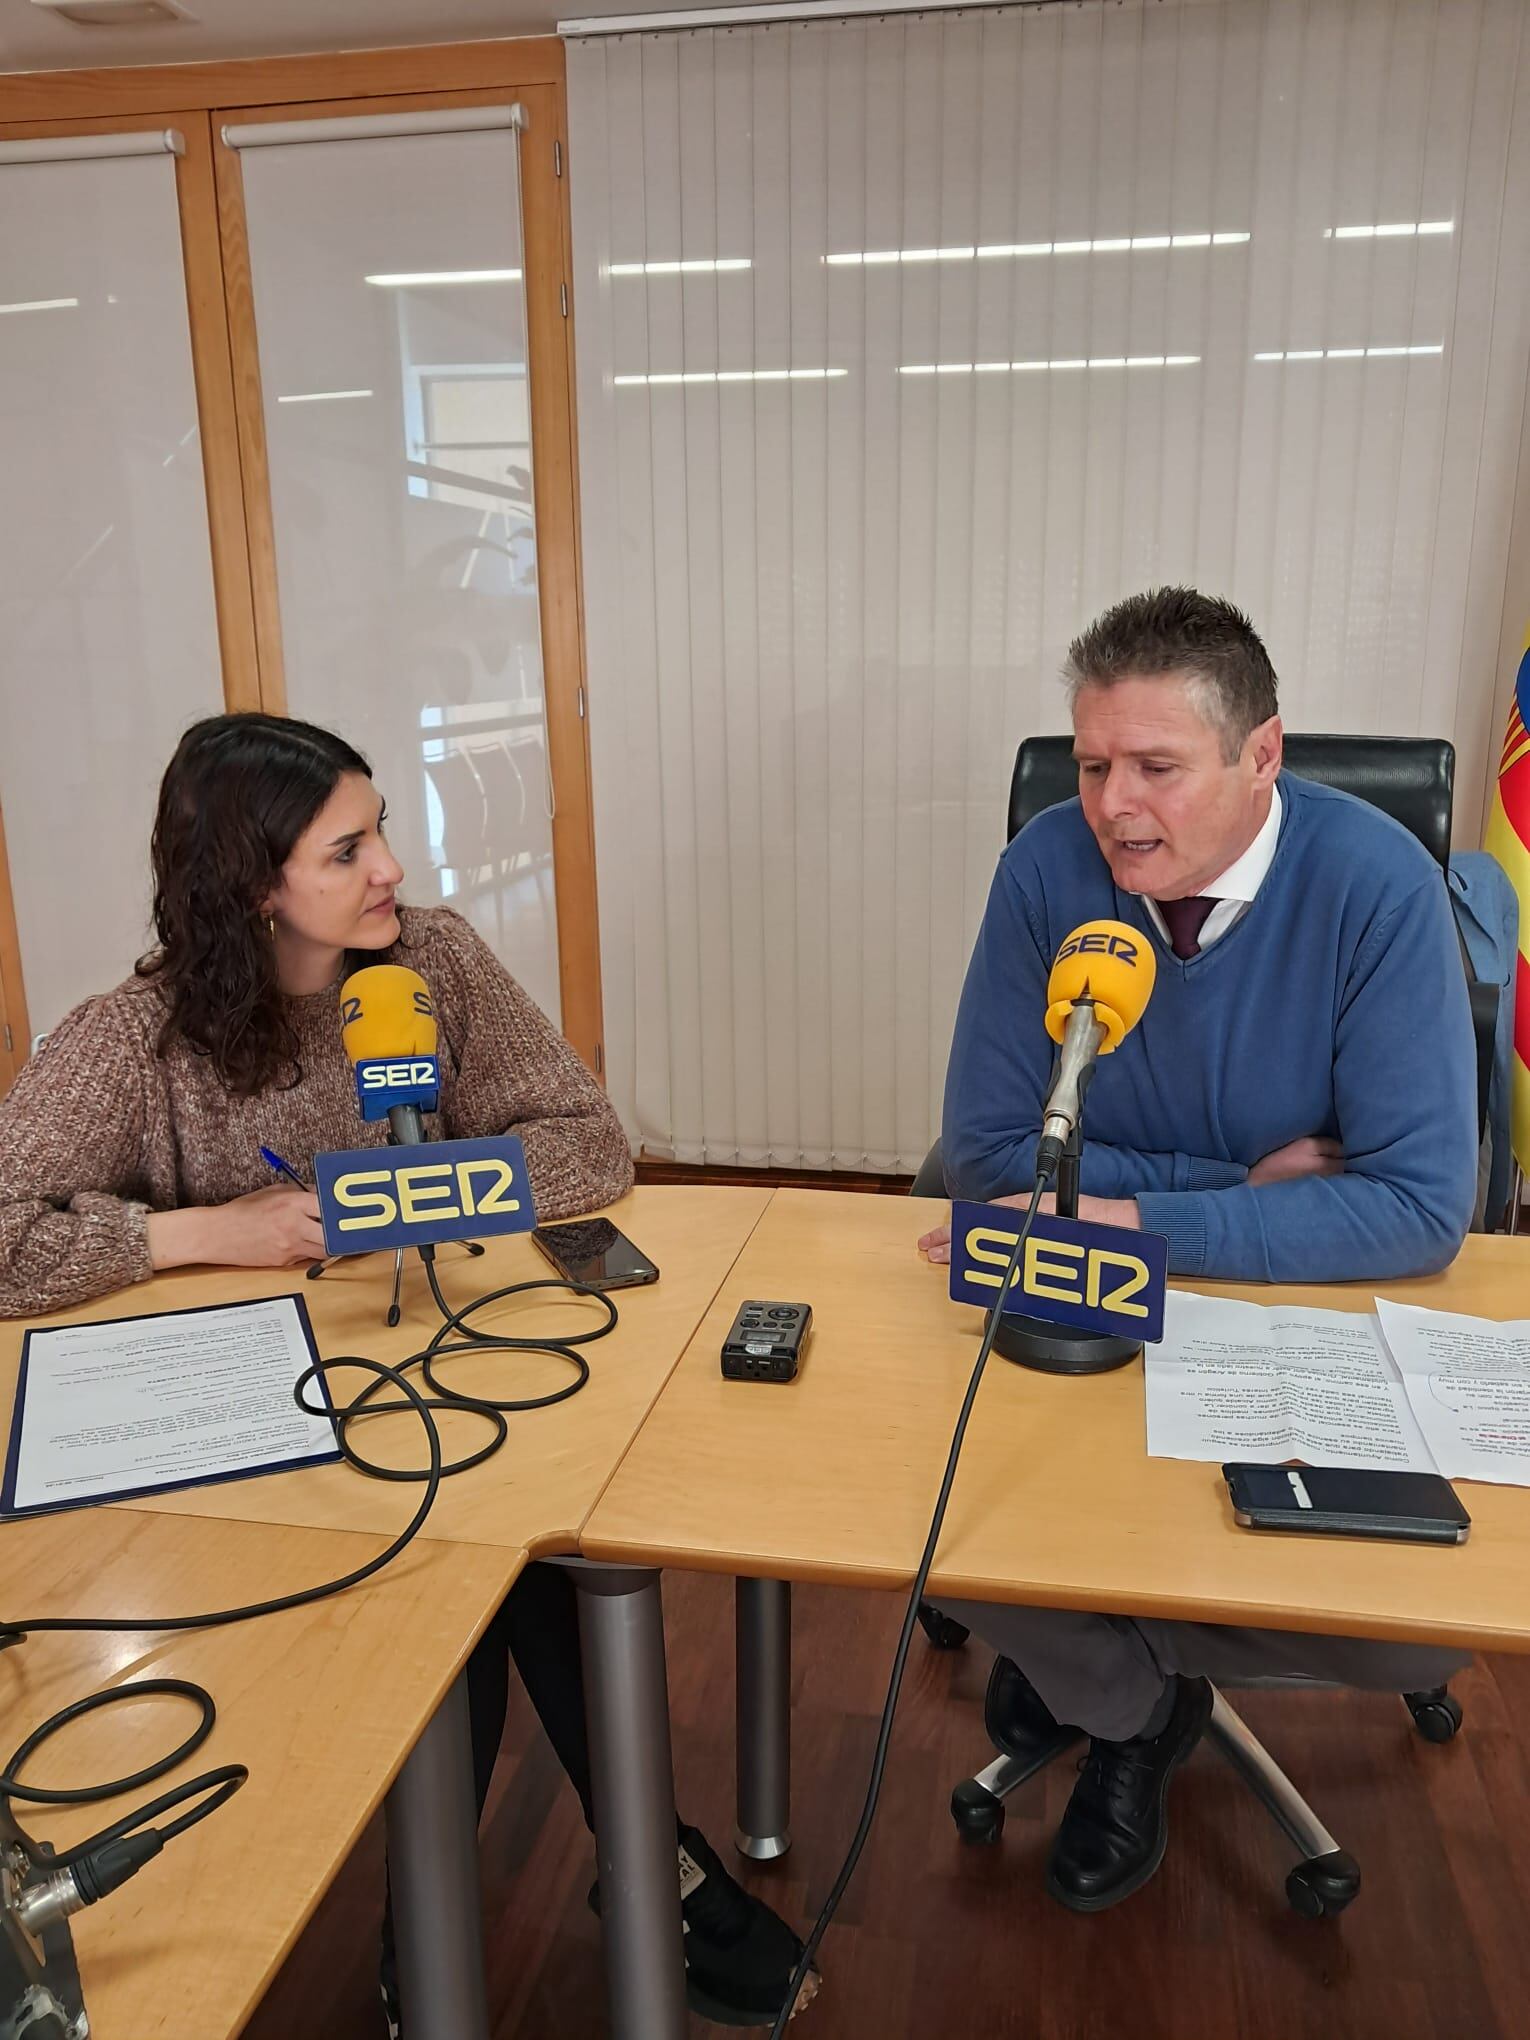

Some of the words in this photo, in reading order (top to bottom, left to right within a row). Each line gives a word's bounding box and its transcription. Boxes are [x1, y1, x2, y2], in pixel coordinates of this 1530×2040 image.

[1055, 933, 1139, 969] SER
[362, 1062, 436, 1089] SER
[333, 1158, 520, 1232] SER
[963, 1226, 1151, 1318] SER
